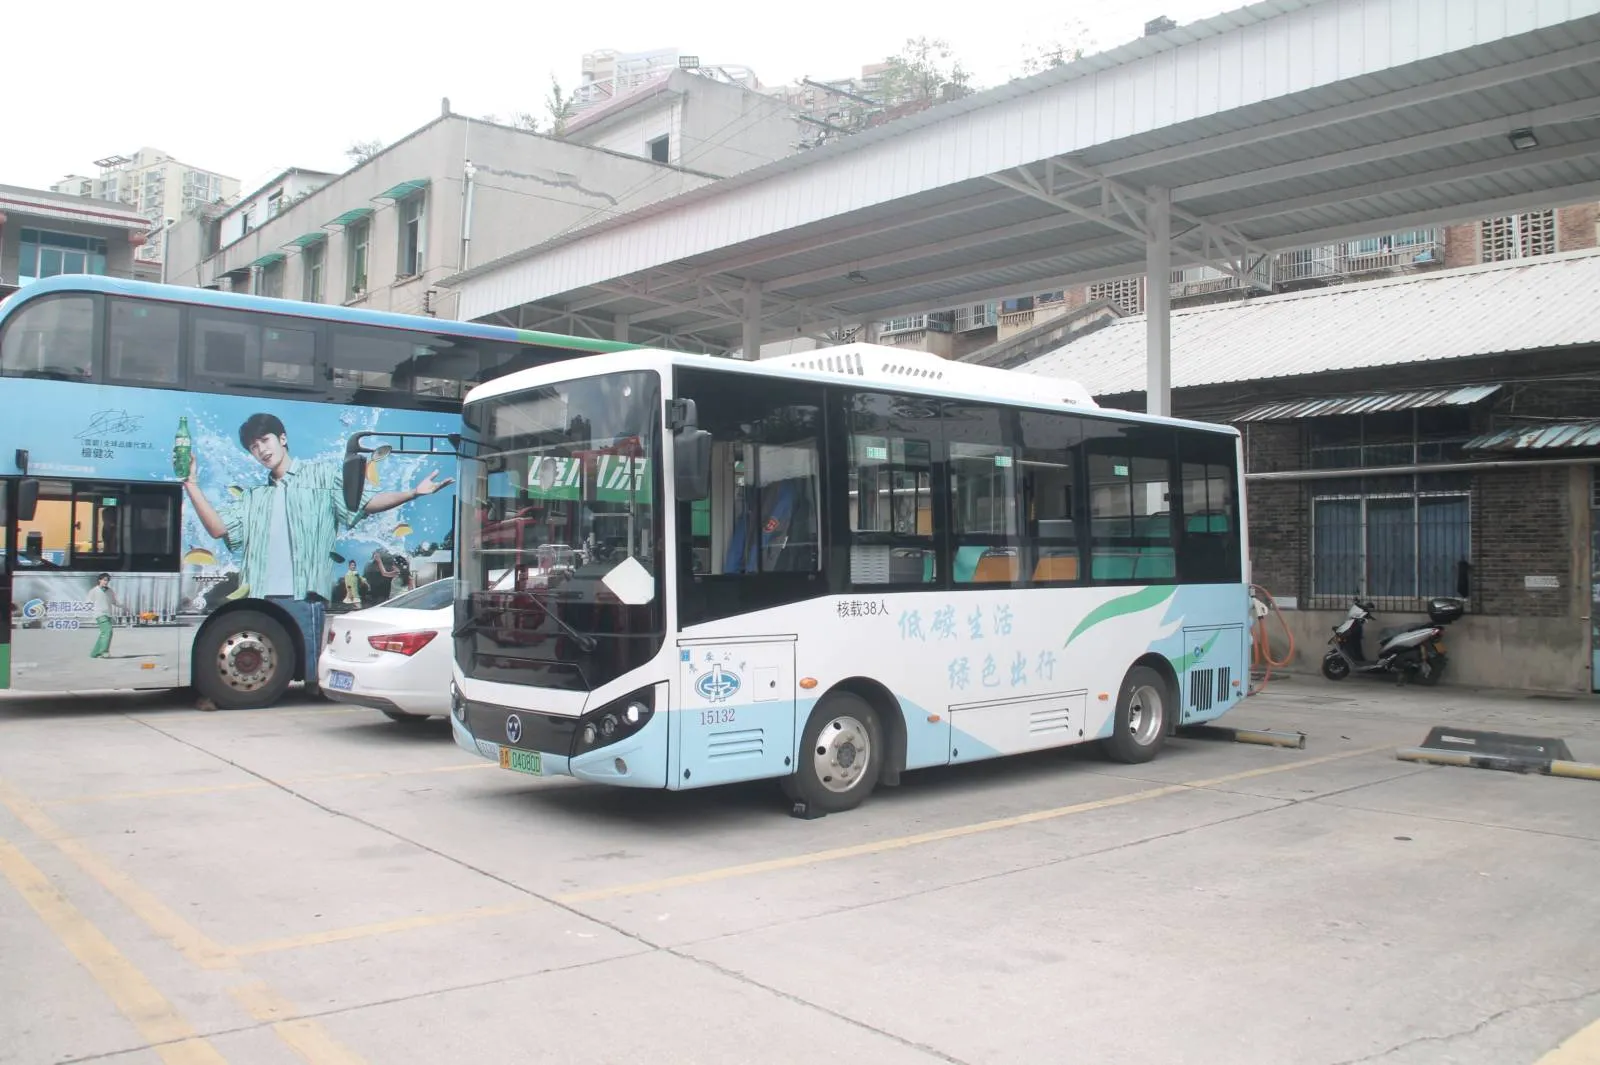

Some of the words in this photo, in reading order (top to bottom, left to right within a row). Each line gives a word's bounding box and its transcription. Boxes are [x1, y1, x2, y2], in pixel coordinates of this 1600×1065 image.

[837, 600, 889, 618] 核载38人
[47, 620, 79, 630] 4679
[898, 604, 1013, 642] 低碳生活
[948, 650, 1057, 690] 绿色出行
[701, 708, 735, 725] 15132
